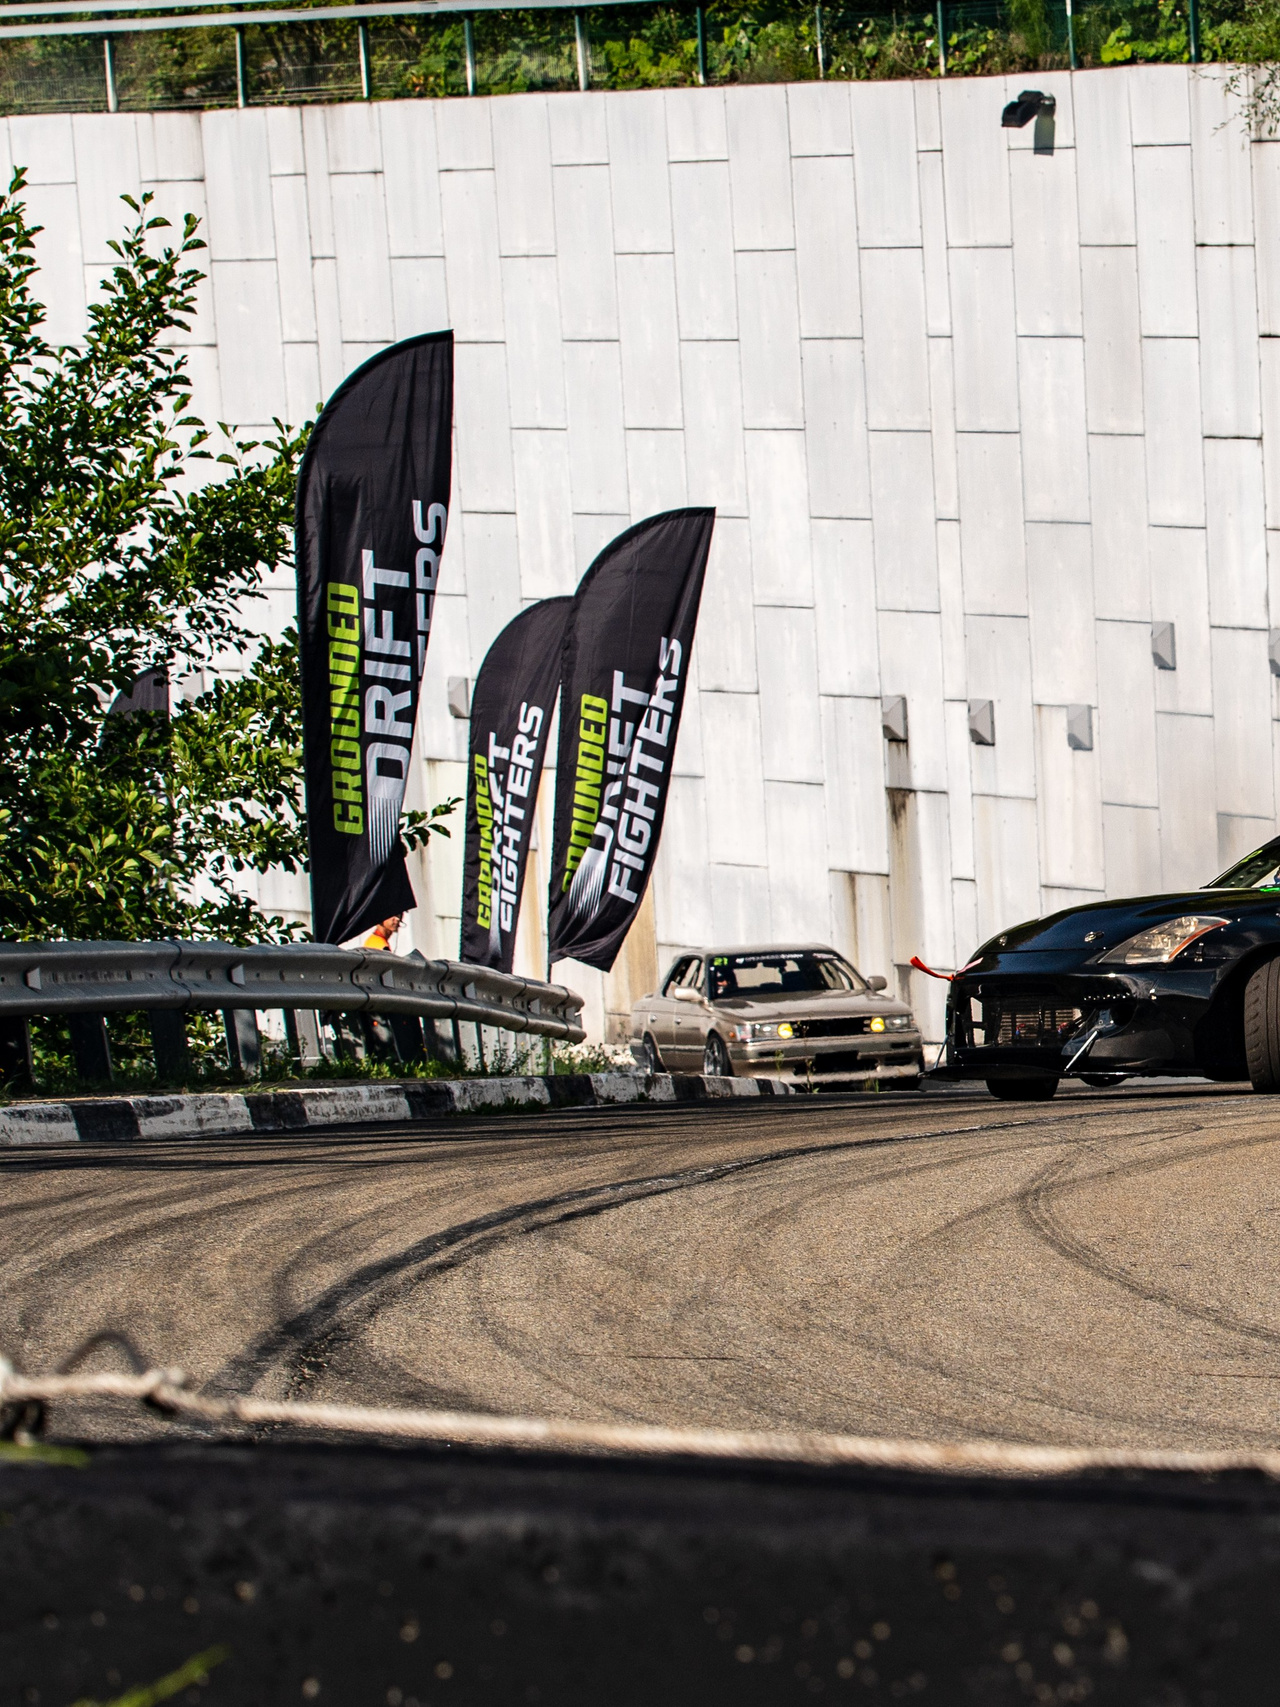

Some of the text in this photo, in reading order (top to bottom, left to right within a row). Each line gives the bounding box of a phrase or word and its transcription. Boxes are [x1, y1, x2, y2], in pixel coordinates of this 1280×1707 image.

[326, 580, 364, 836] GROUNDED
[361, 548, 412, 866] DRIFT
[500, 701, 544, 933] FIGHTERS
[607, 636, 683, 904] FIGHTERS
[474, 753, 494, 930] GROUNDED
